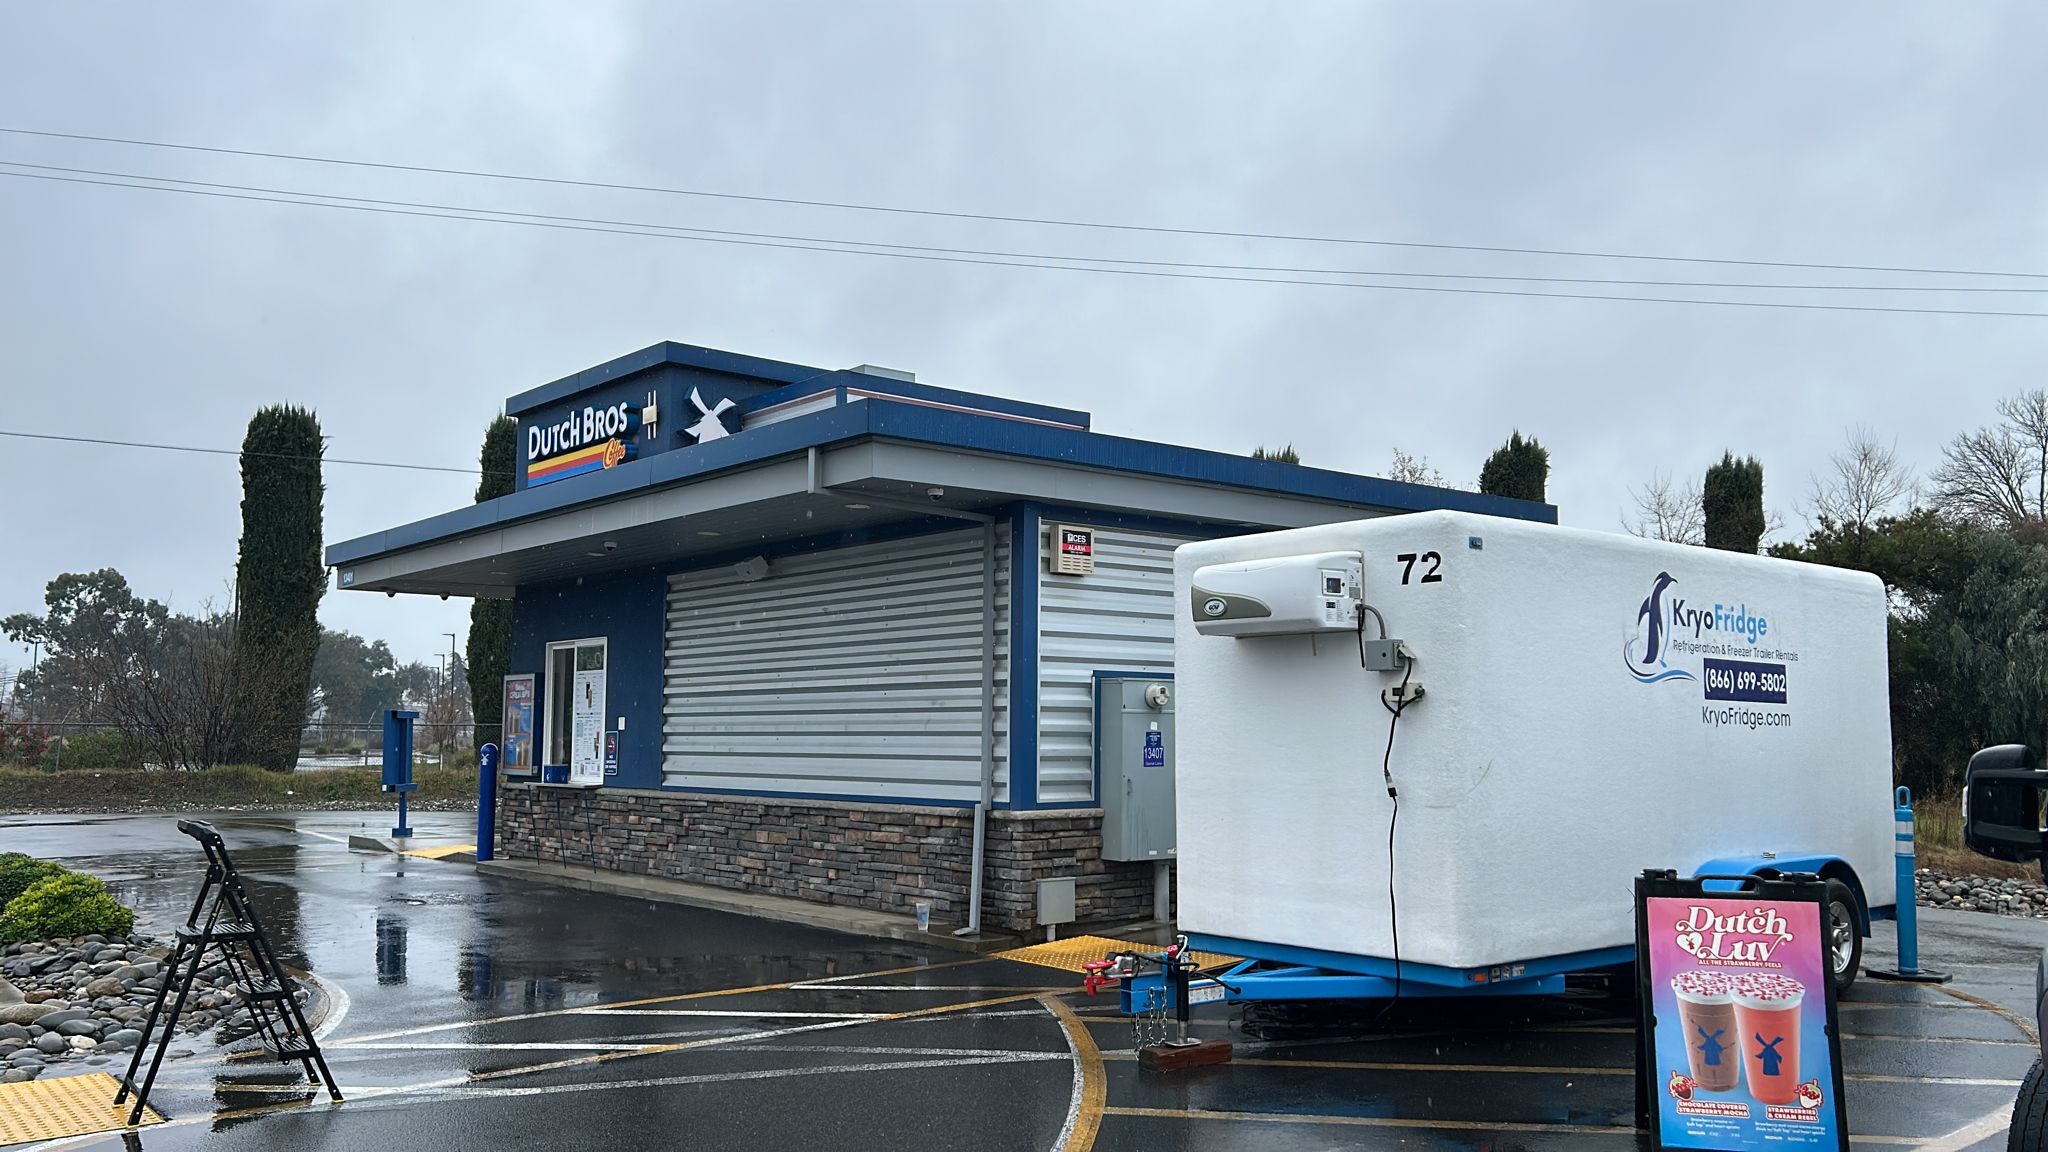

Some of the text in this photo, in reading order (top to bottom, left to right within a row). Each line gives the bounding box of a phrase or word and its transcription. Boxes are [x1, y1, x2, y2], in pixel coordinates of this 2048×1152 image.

[528, 401, 628, 460] DUTCH BROS
[603, 438, 626, 469] Coffee
[1068, 544, 1086, 552] ALARM
[1397, 551, 1442, 585] 72
[1673, 598, 1768, 644] KryoFridge
[1673, 639, 1799, 661] Refrigeration & Freezer Trailer Rentals
[1705, 668, 1786, 693] (866) 699-5802
[1702, 706, 1791, 730] KryoFridge.com
[1144, 747, 1163, 759] 13407
[1675, 905, 1788, 935] Dutch
[1696, 931, 1793, 962] Luv
[1723, 960, 1764, 968] STRAWBERRY
[1764, 961, 1782, 969] FEELS
[1678, 1107, 1722, 1115] STRAWBERRY
[1679, 1101, 1716, 1109] CHOCOLATE
